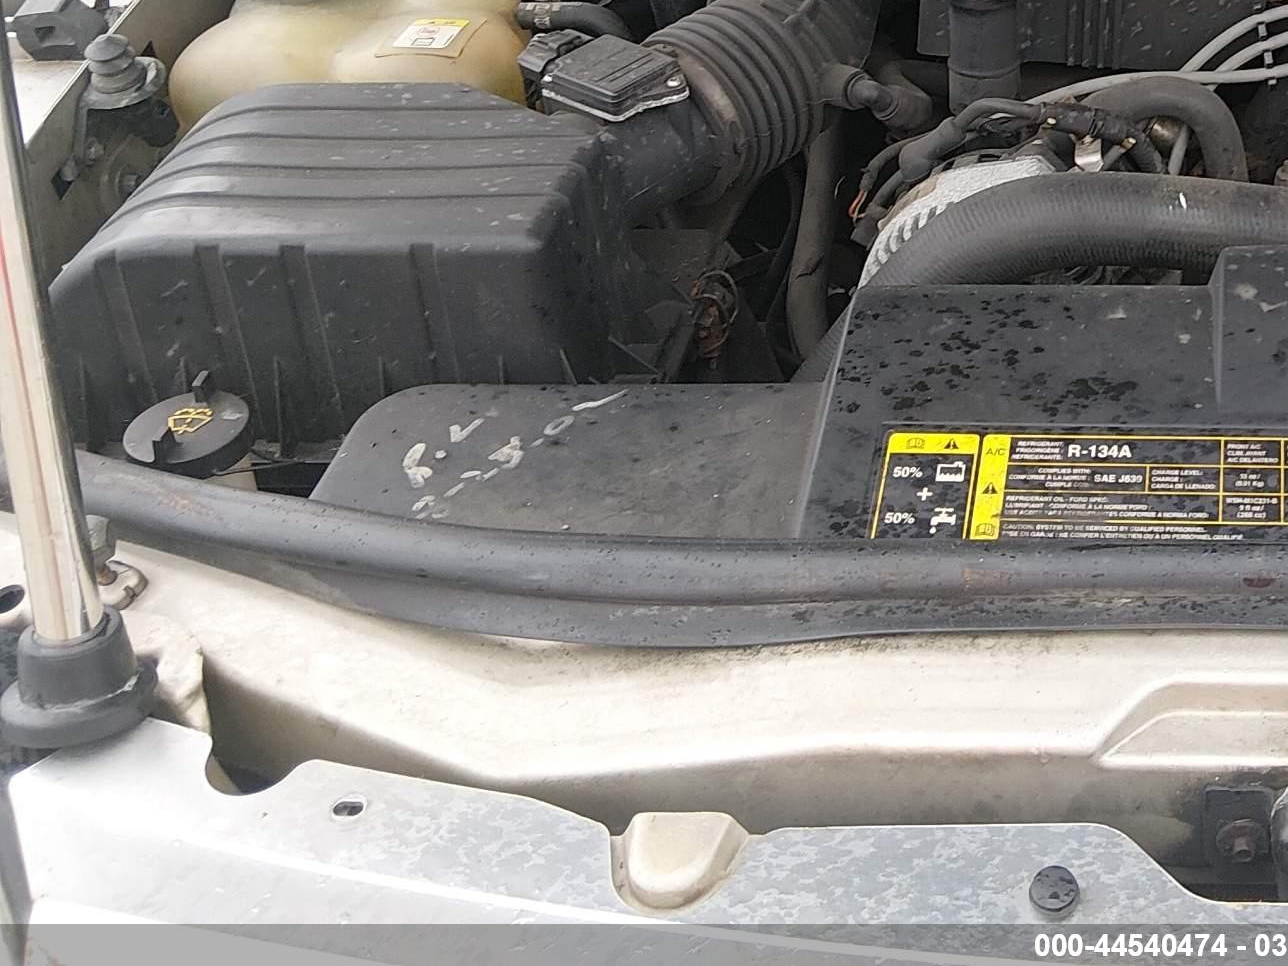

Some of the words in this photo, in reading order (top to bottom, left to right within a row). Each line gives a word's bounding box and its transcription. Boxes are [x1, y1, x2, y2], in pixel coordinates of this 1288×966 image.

[1067, 444, 1132, 458] R-134A
[892, 466, 923, 478] 50%
[1094, 474, 1116, 482] SAE
[1118, 474, 1143, 483] J639
[884, 512, 916, 524] 50%
